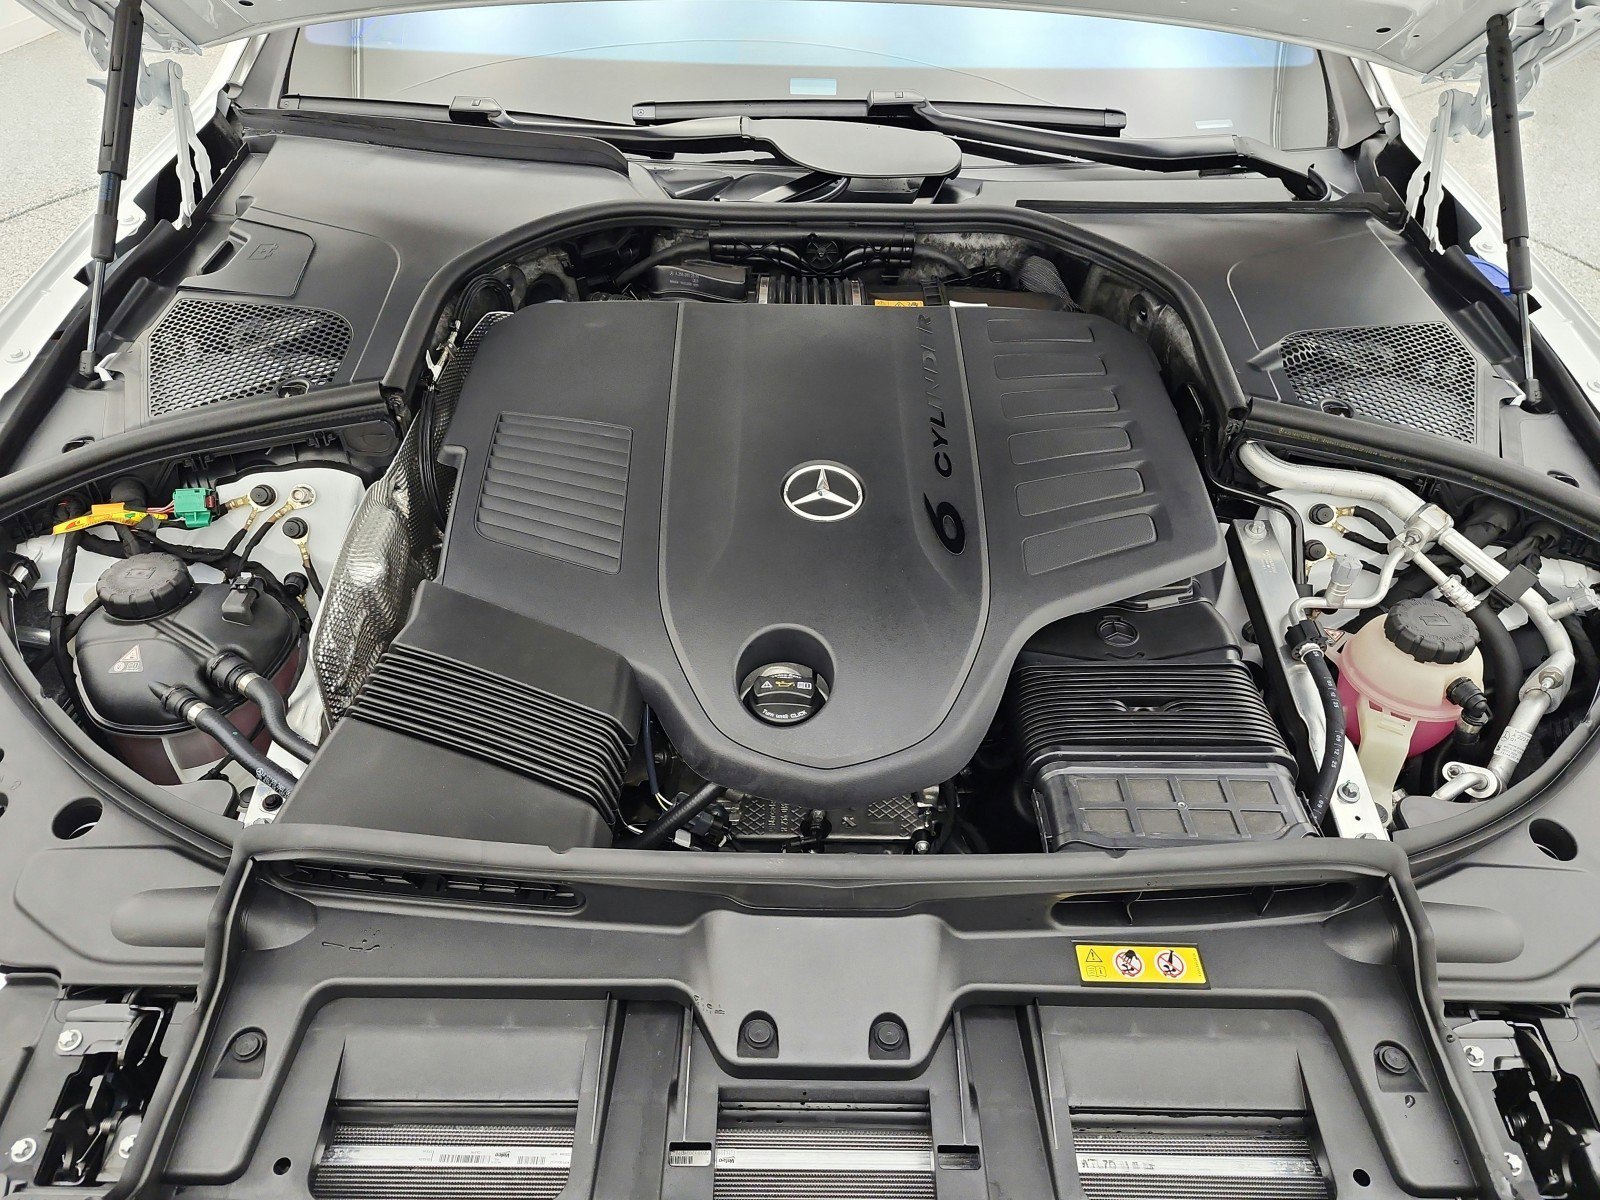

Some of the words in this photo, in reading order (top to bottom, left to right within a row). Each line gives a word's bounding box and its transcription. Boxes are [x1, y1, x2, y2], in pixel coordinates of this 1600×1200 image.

[923, 492, 966, 556] 6
[762, 708, 775, 718] Turn
[790, 709, 808, 719] CLICK
